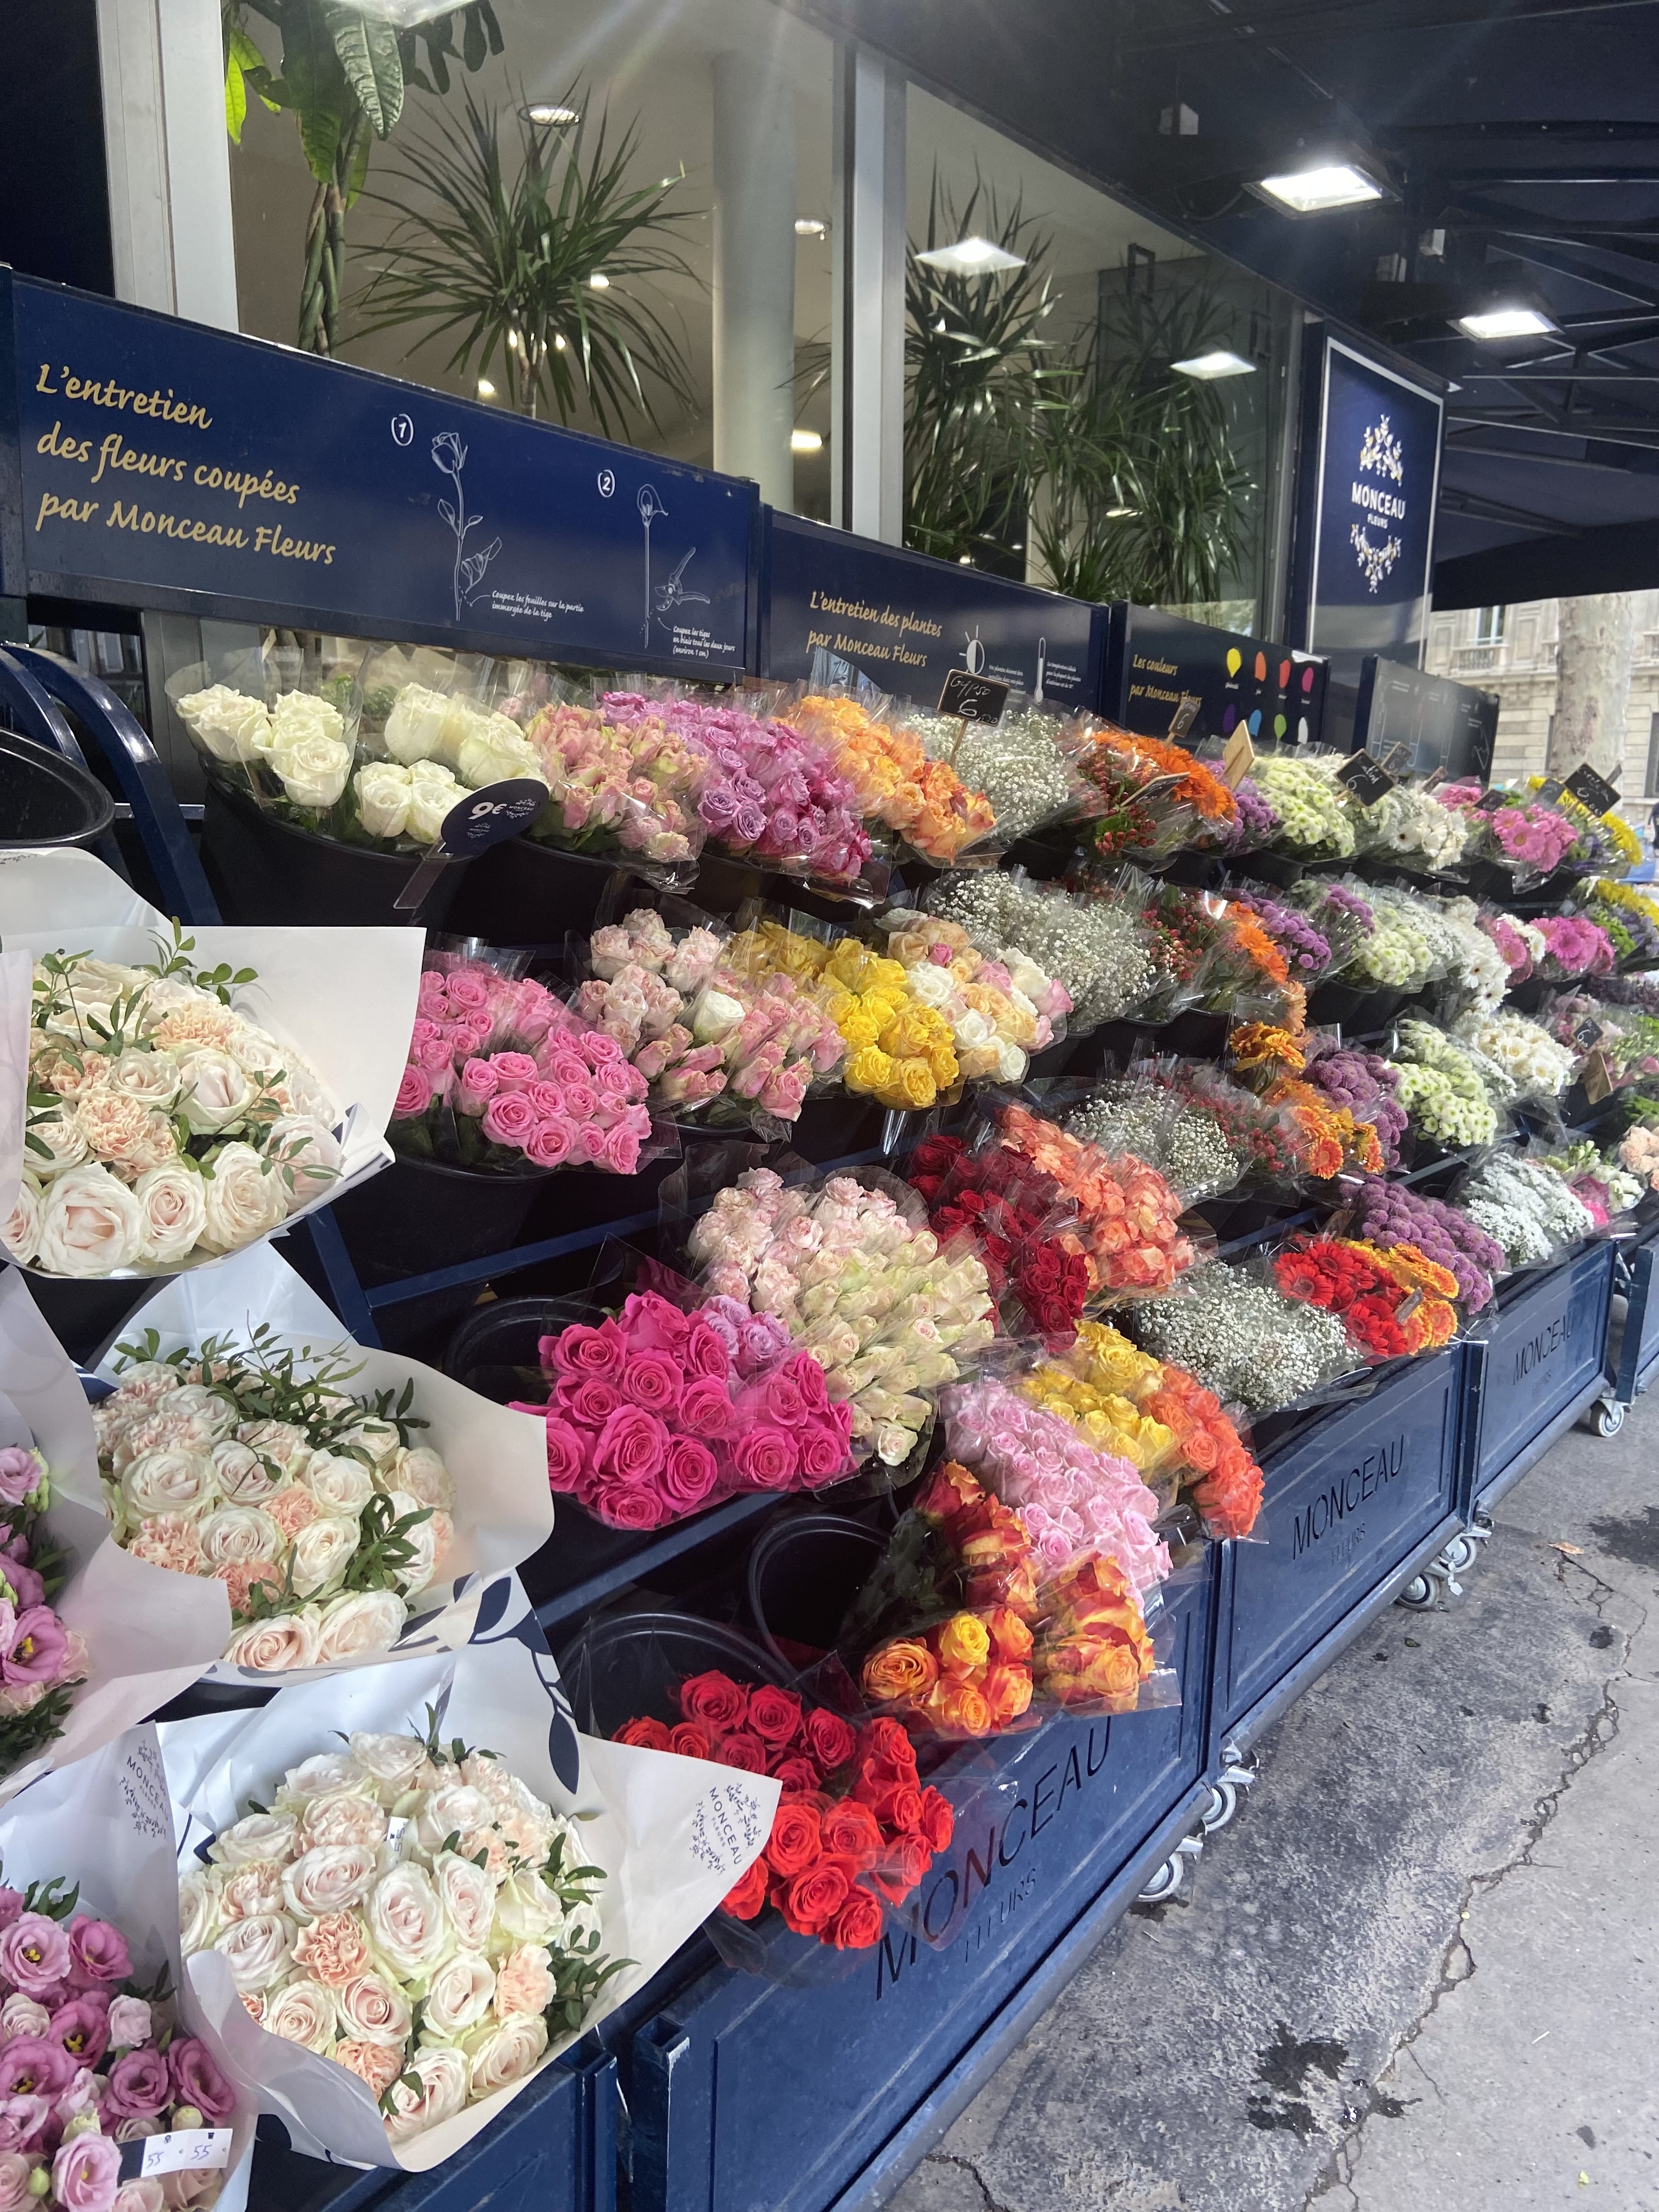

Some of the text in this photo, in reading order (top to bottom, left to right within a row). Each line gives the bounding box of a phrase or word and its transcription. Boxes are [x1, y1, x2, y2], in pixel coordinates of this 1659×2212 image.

[36, 363, 213, 430] L'entretien
[37, 421, 300, 509] des fleurs coupées
[1351, 481, 1406, 520] MONCEAU
[35, 492, 336, 565] par Monceau Fleurs
[492, 590, 515, 603] Coupez
[516, 592, 525, 603] les
[524, 594, 548, 607] feuilles
[558, 599, 566, 610] la
[565, 603, 585, 613] partie
[492, 600, 553, 622] immergée de la tige
[809, 590, 943, 638] L'entretien des plantes
[805, 630, 928, 668] par Monceau Fleurs
[1133, 653, 1178, 676] Les couleurs
[1128, 684, 1146, 702] par
[1293, 1434, 1404, 1560] MONCEAU
[709, 1786, 742, 1865] MONCEAU
[876, 1716, 1112, 2001] MONCEAU
[190, 2144, 213, 2160] 55
